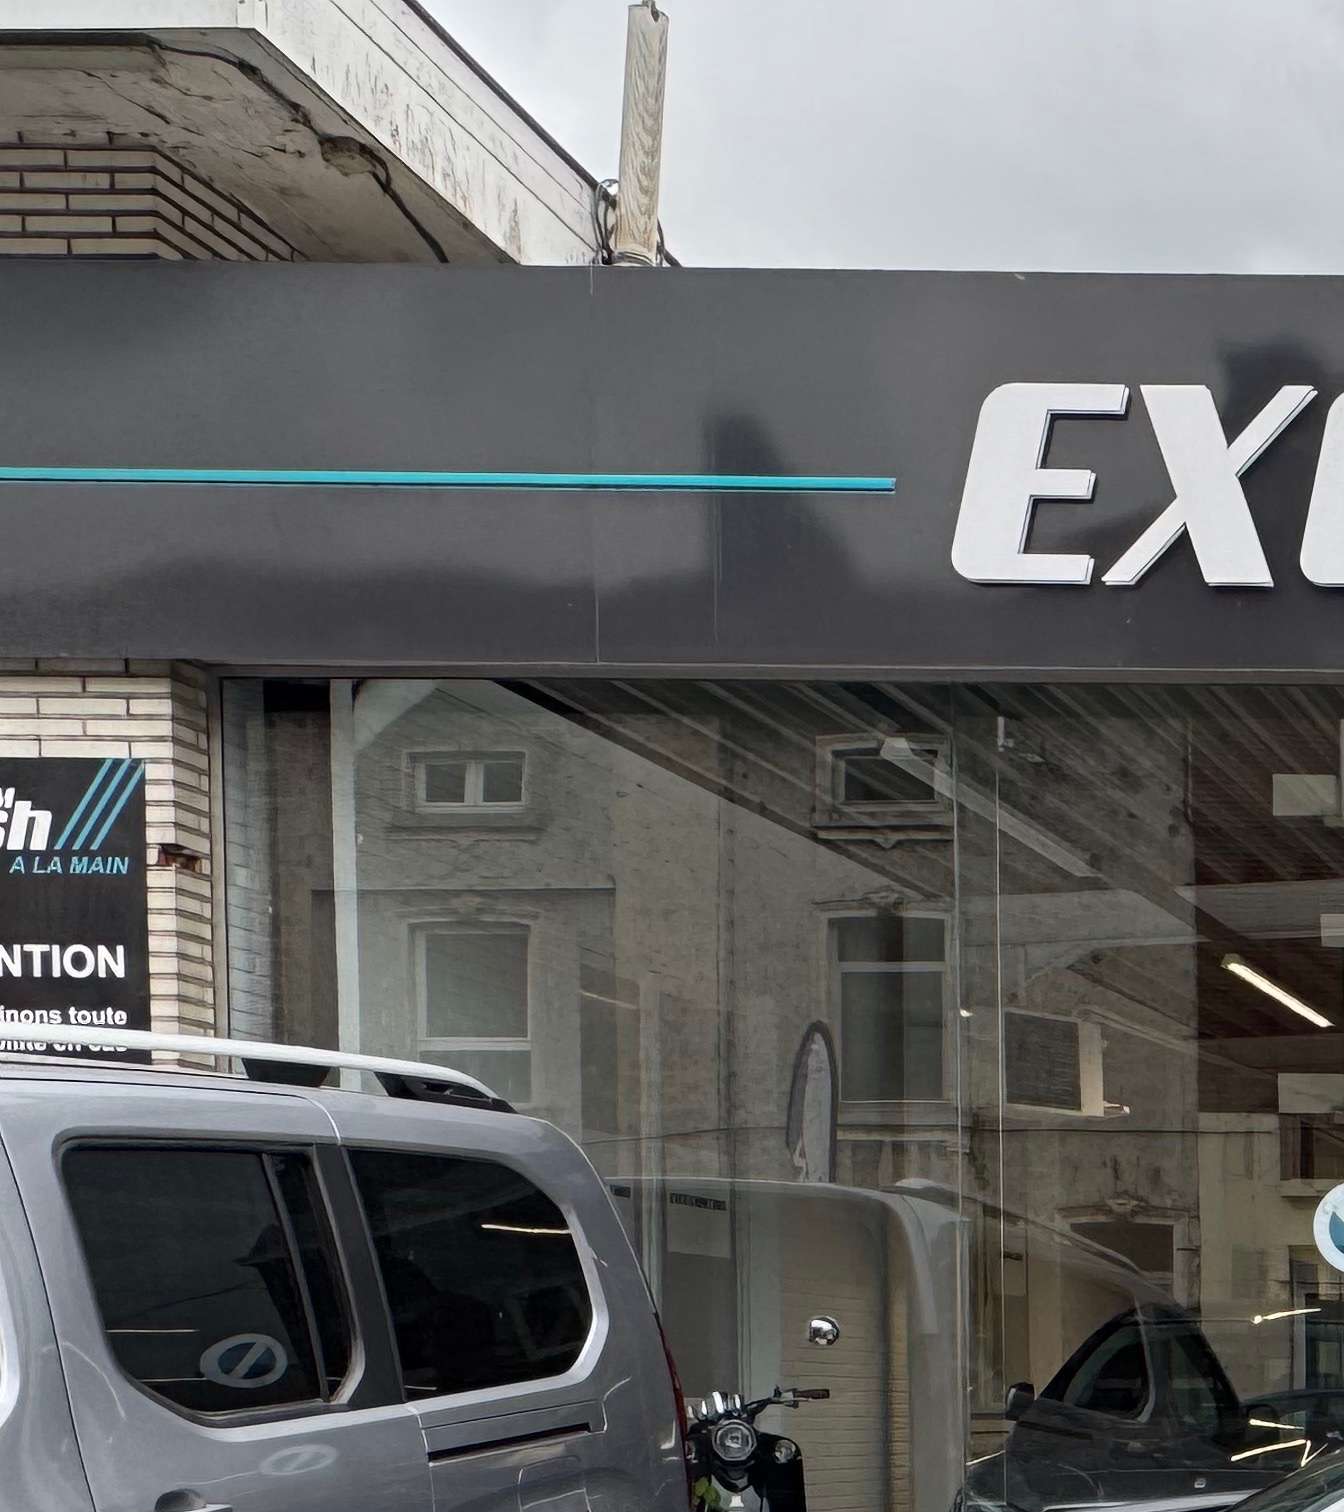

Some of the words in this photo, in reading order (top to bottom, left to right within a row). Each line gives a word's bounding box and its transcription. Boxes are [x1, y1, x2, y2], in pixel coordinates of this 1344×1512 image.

[9, 856, 24, 874] A
[32, 856, 62, 874] LA
[69, 856, 129, 874] MAIN
[0, 944, 126, 978] NTION
[69, 1006, 128, 1025] toute
